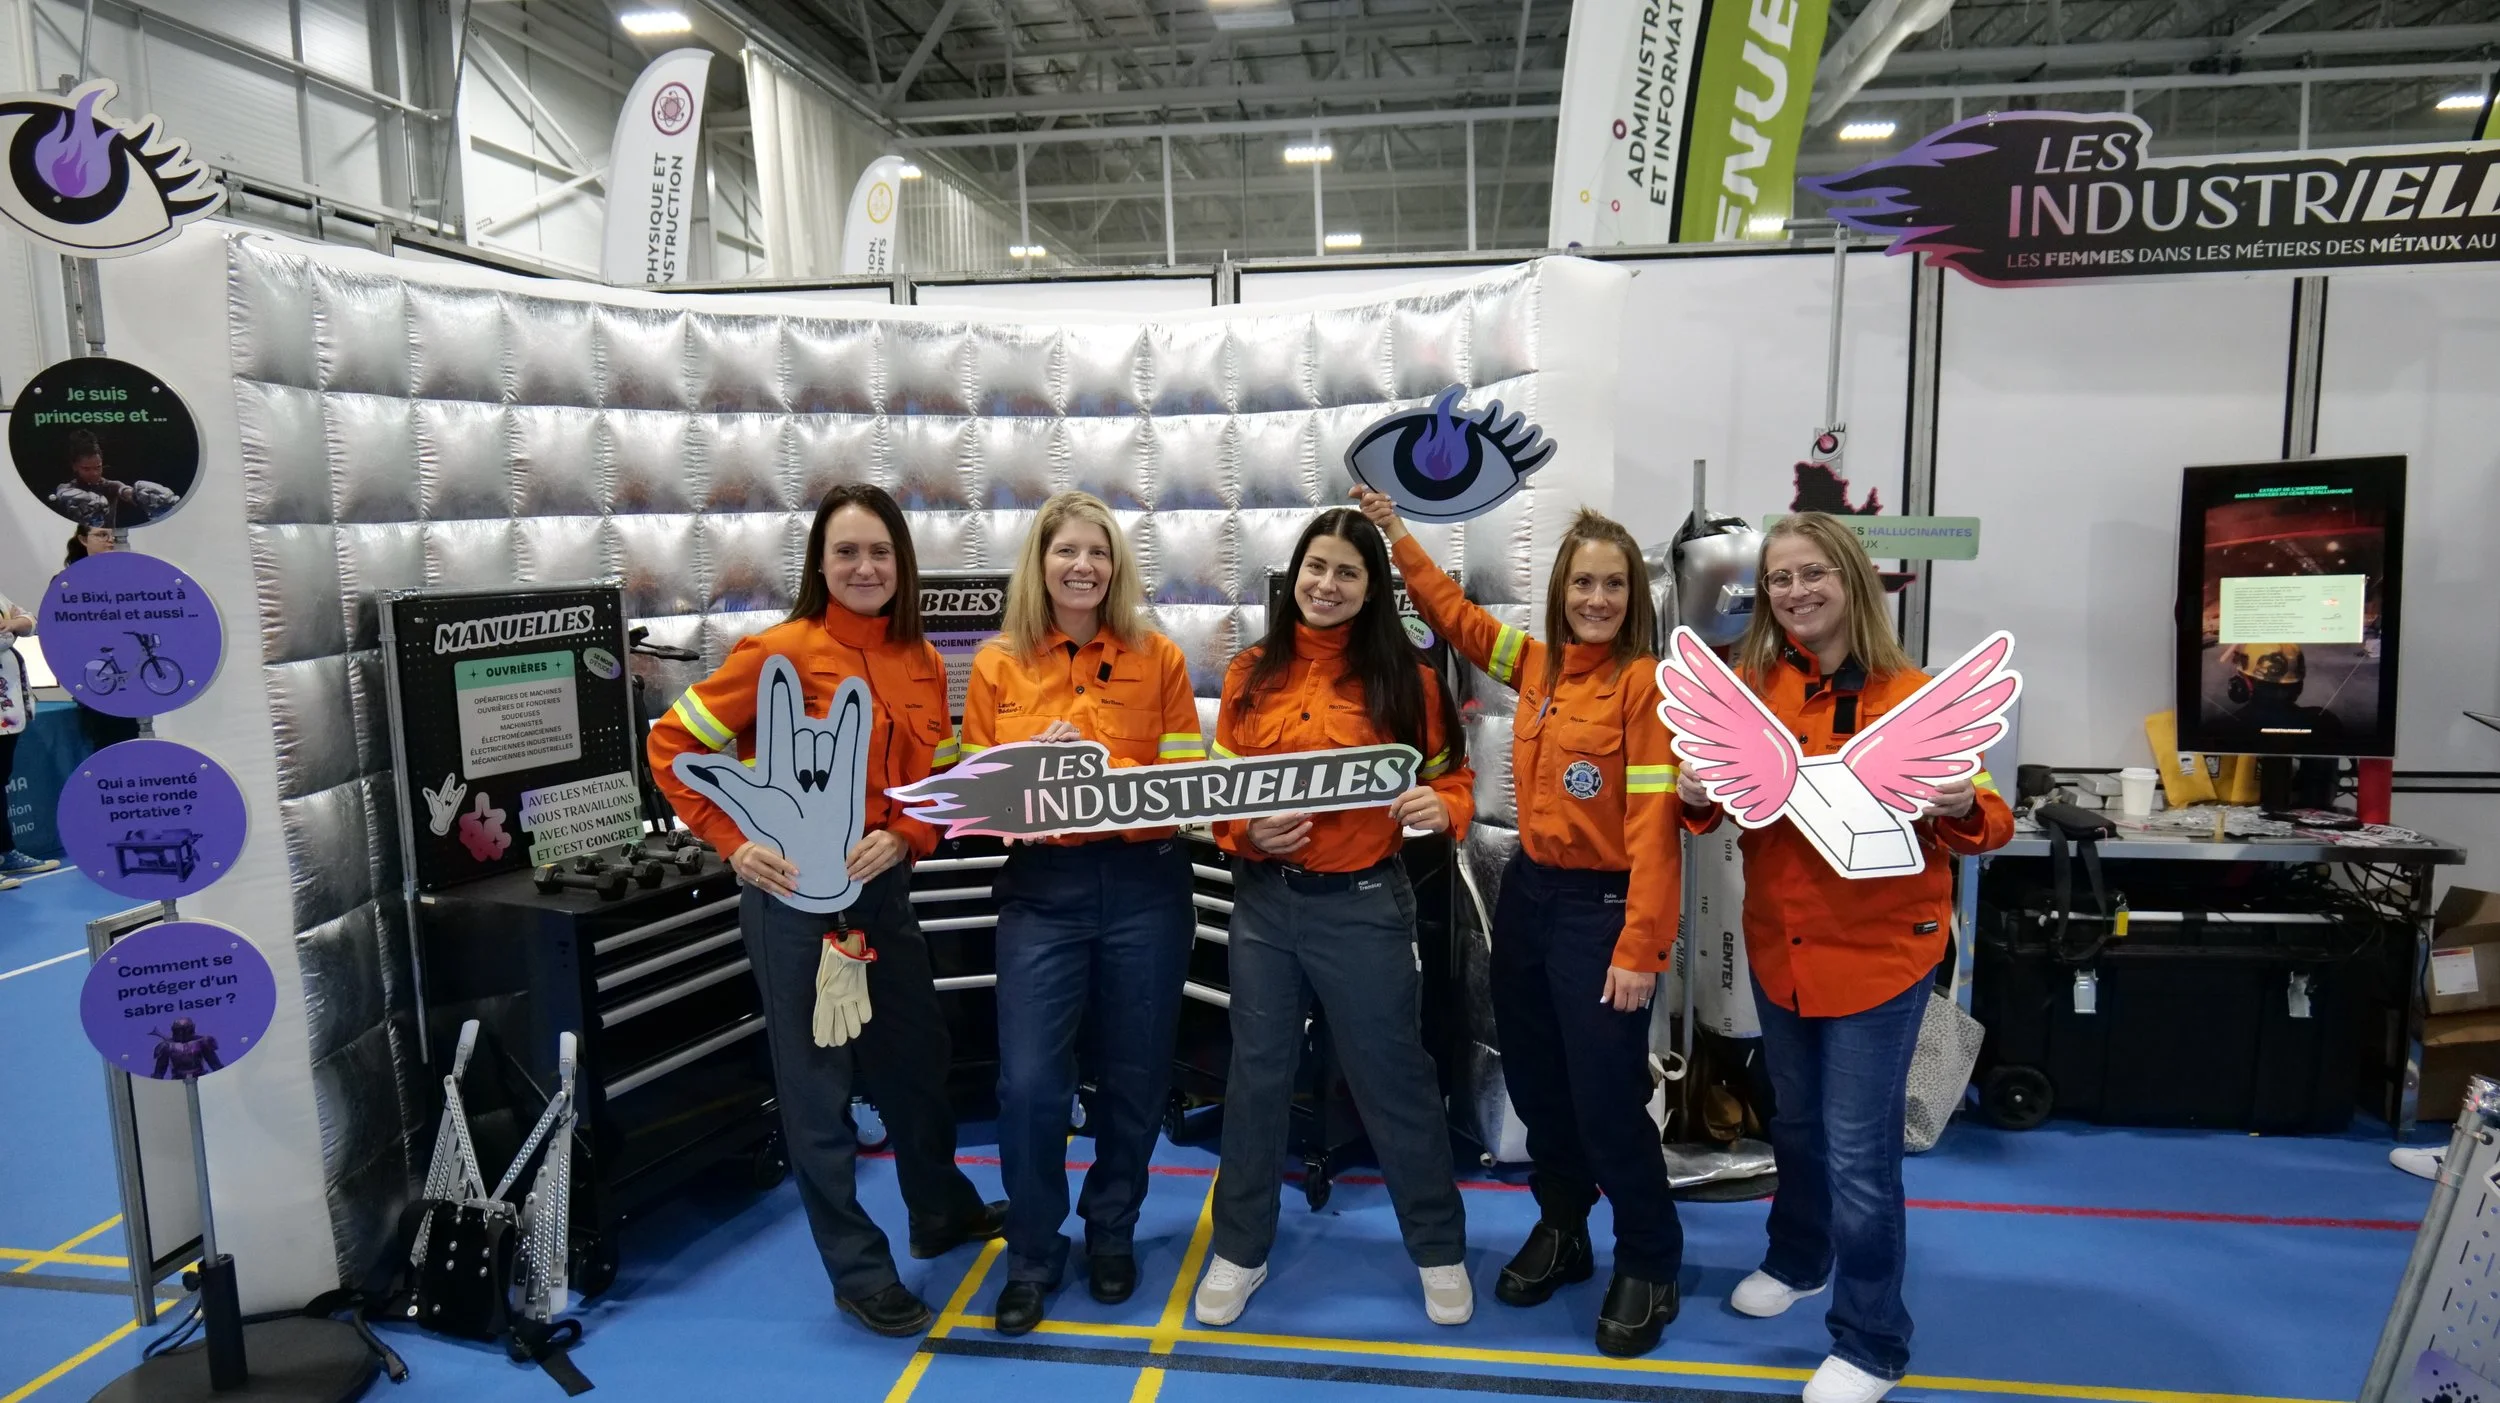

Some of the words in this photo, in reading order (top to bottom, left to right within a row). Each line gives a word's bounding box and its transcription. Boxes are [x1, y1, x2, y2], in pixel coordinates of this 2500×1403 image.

[654, 152, 667, 177] ET
[2034, 133, 2132, 174] LES
[1650, 165, 1668, 205] ET
[646, 181, 664, 283] PHYSIQUE
[2007, 253, 2040, 268] LES
[2045, 249, 2134, 266] FEMMES
[2138, 247, 2191, 263] DANS
[2196, 244, 2231, 260] LES
[2235, 240, 2321, 259] MÉTIERS
[2325, 239, 2365, 256] DES
[2370, 233, 2462, 253] MÉTAUX
[2466, 233, 2496, 249] AU
[67, 387, 85, 402] Je
[89, 387, 128, 401] suis
[34, 409, 125, 426] princesse
[129, 410, 149, 423] et
[1868, 527, 1973, 537] HALLUCINANTES
[61, 593, 78, 604] Le
[81, 591, 112, 604] Bixi,
[115, 589, 174, 604] partout
[177, 588, 186, 600] à
[54, 609, 121, 622] Montréal
[125, 609, 140, 619] et
[143, 606, 184, 619] aussi
[437, 608, 592, 650] MANUELLES
[486, 661, 547, 678] OUVRIÈRES
[474, 692, 519, 704] OPÉRATRICES
[529, 687, 562, 697] MACHINES
[477, 702, 515, 714] OUVRIÈRES
[526, 697, 561, 707] FONDERIES
[500, 719, 543, 730] MACHINISTES
[501, 709, 541, 720] SOUDEUSES
[470, 741, 526, 756] ÉLECTRICIENNES
[526, 733, 573, 747] INDUSTRIELLES
[481, 725, 562, 744] ÉLECTROMÉCANICIENNES
[471, 751, 526, 766] MÉCANICIENNES
[526, 742, 573, 756] INDUSTRIELLES
[1038, 753, 1097, 782] LES
[97, 778, 123, 790] Qui
[126, 779, 136, 788] a
[139, 772, 197, 787] inventé
[528, 793, 559, 808] AVEC
[561, 787, 581, 801] LES
[582, 777, 629, 796] MÉTAUX,
[1023, 756, 1406, 824] INDUSTRIELLES
[100, 794, 114, 805] la
[118, 792, 149, 804] scie
[152, 789, 198, 802] ronde
[527, 809, 561, 826] NOUS
[562, 792, 635, 818] TRAVAILLONS
[110, 805, 180, 822] portative
[183, 804, 193, 815] ?
[539, 825, 569, 842] AVEC
[570, 819, 594, 834] NOS
[595, 810, 632, 828] MAINS
[537, 847, 551, 861] ET
[553, 839, 584, 857] C'EST
[585, 825, 640, 849] CONCRET
[118, 955, 209, 978] Comment
[212, 954, 233, 967] se
[1721, 931, 1734, 990] GENTEX
[118, 979, 197, 1001] protéger
[200, 974, 238, 988] d'un
[124, 1000, 175, 1018] sabre
[179, 996, 222, 1012] laser
[225, 992, 236, 1004] ?
